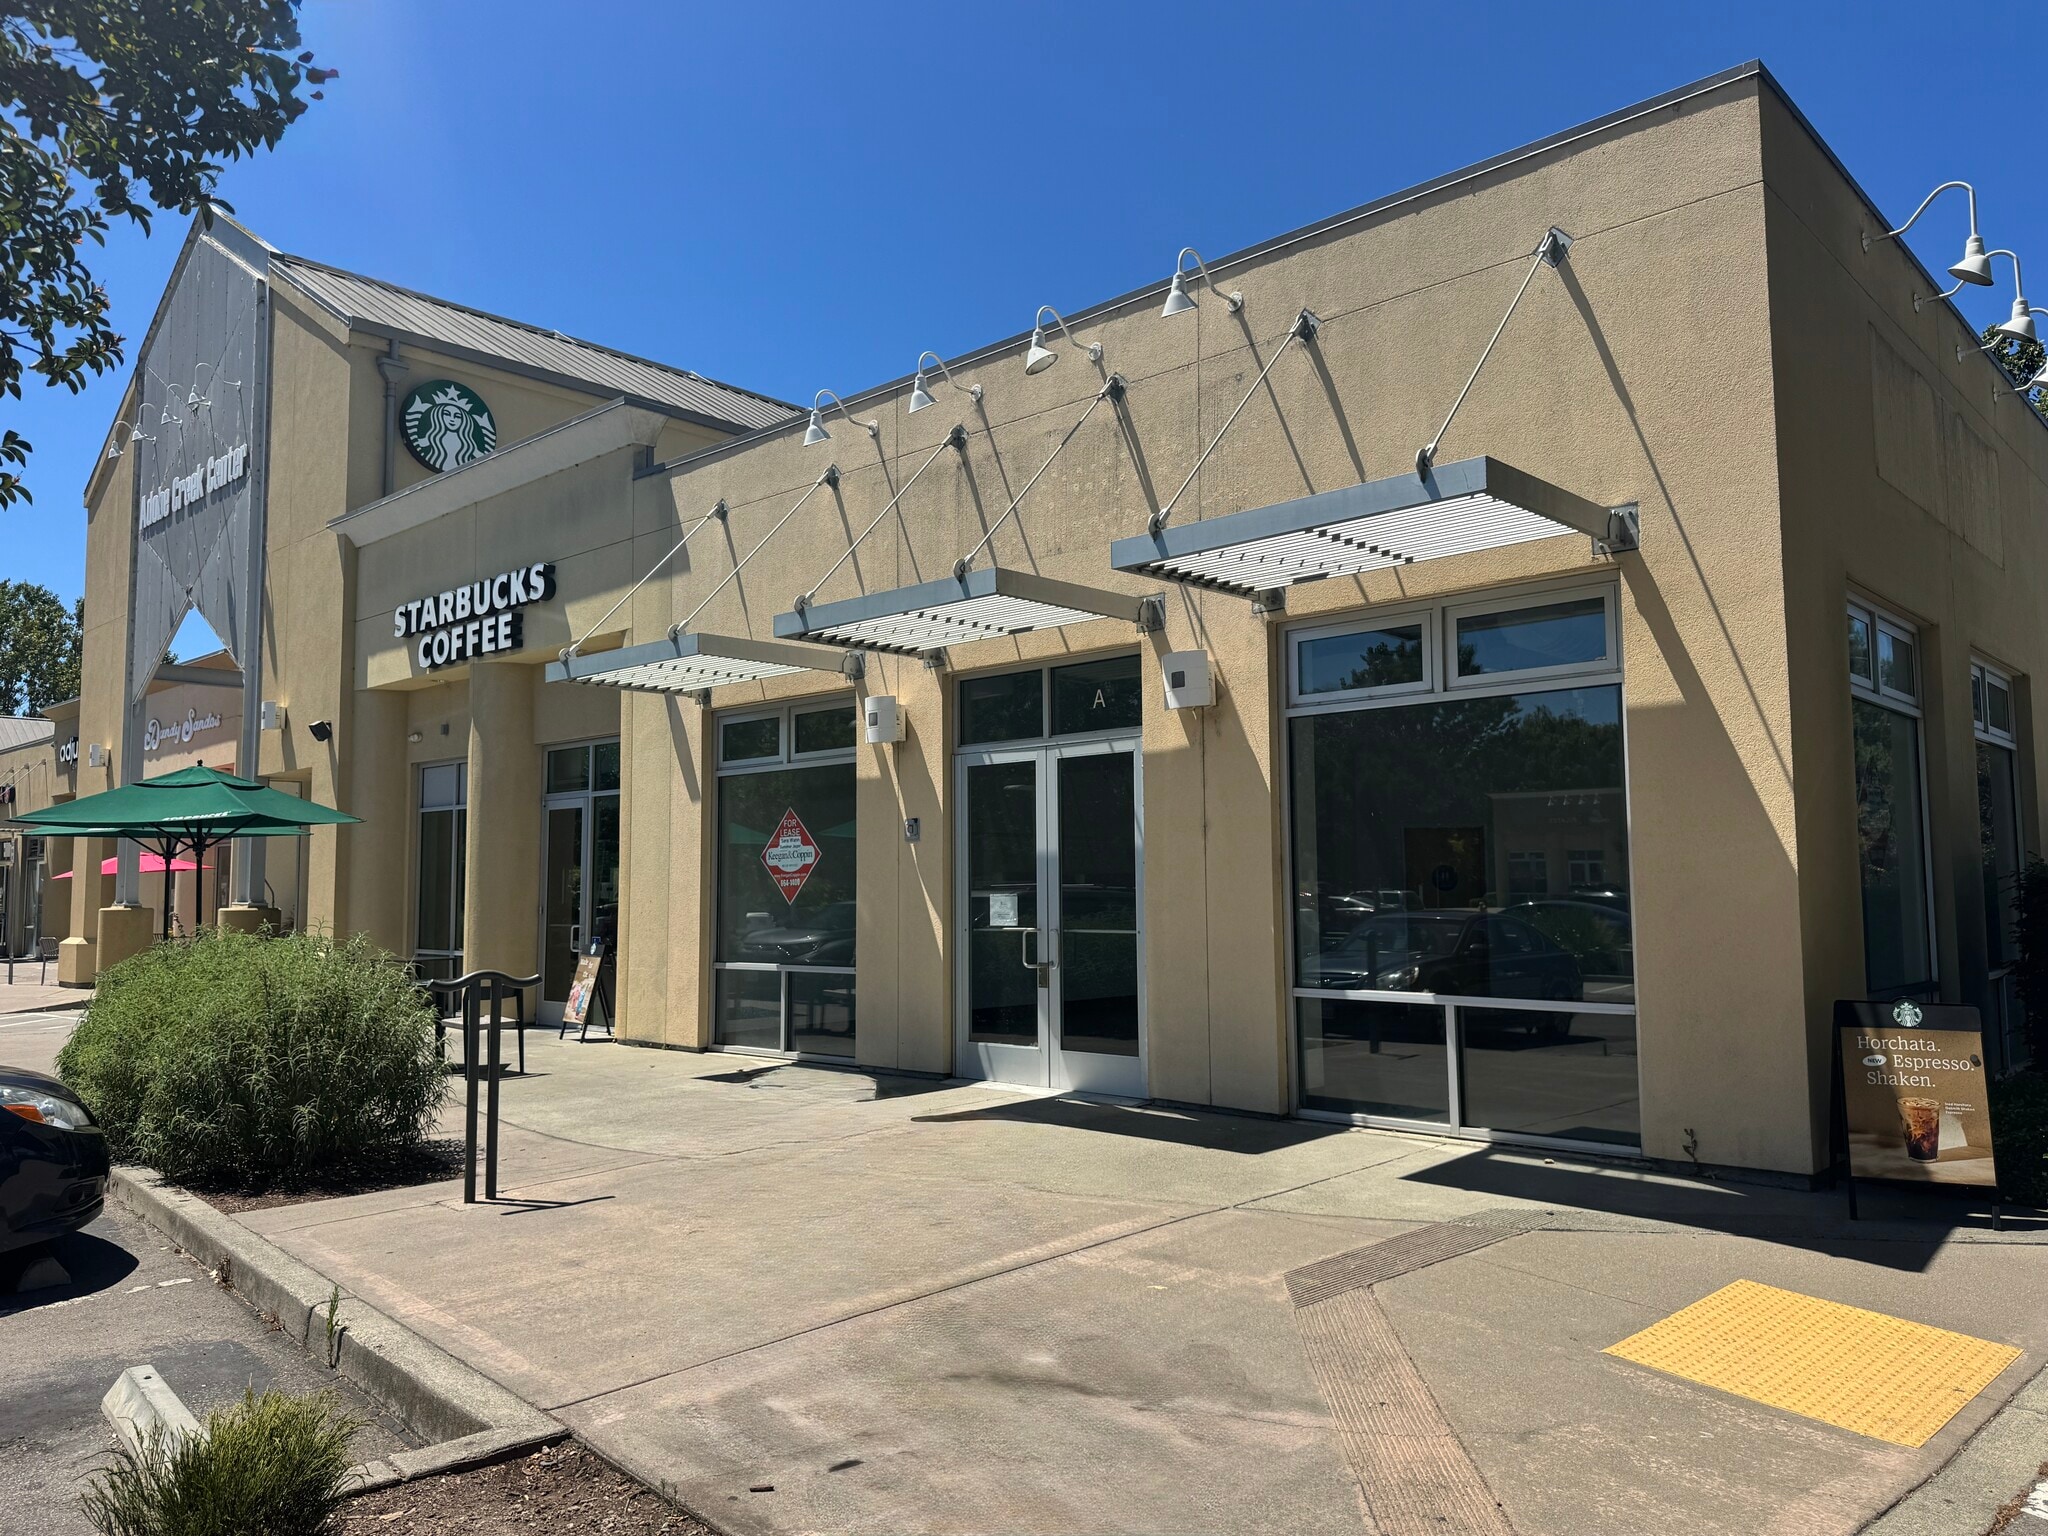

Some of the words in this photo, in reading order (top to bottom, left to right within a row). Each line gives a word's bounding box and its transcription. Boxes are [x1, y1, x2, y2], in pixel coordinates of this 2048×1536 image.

[140, 487, 170, 530] Adobe
[172, 463, 206, 512] Creek
[207, 443, 248, 493] Center
[394, 562, 549, 638] STARBUCKS
[418, 612, 515, 668] COFFEE
[1092, 689, 1107, 709] A
[144, 719, 181, 751] Dandy
[779, 828, 801, 837] LEASE
[783, 819, 797, 828] FOR
[1857, 1036, 1941, 1052] Horchata.
[1892, 1054, 1975, 1071] Espresso.
[1866, 1071, 1936, 1087] Shaken.
